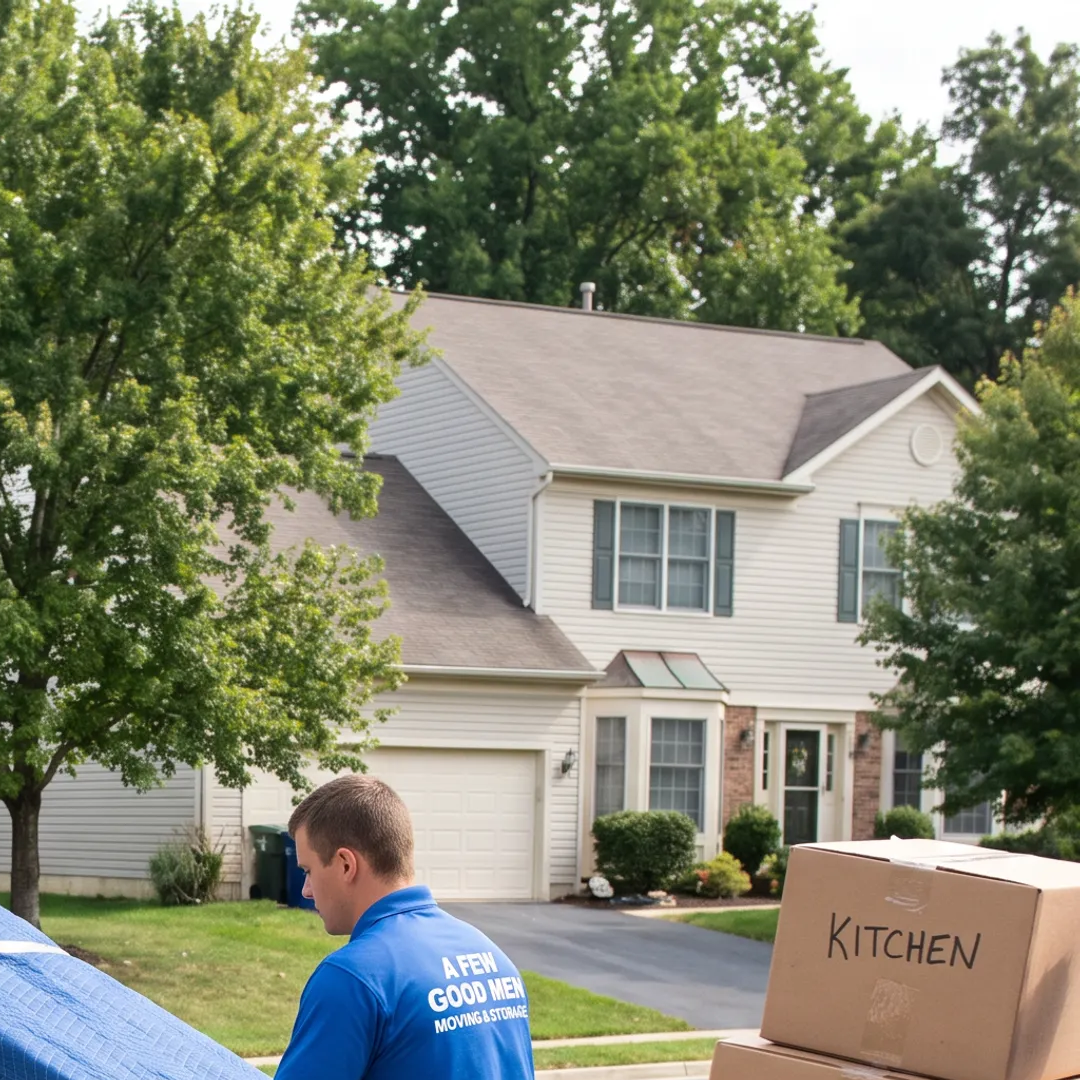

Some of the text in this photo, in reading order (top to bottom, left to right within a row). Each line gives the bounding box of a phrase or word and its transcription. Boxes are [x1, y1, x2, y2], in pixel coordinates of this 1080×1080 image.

[827, 912, 981, 970] KITCHEN
[441, 952, 498, 980] A FEW
[427, 976, 526, 1013] GOOD MEN
[434, 1011, 483, 1034] MOVING
[483, 1009, 491, 1023] &
